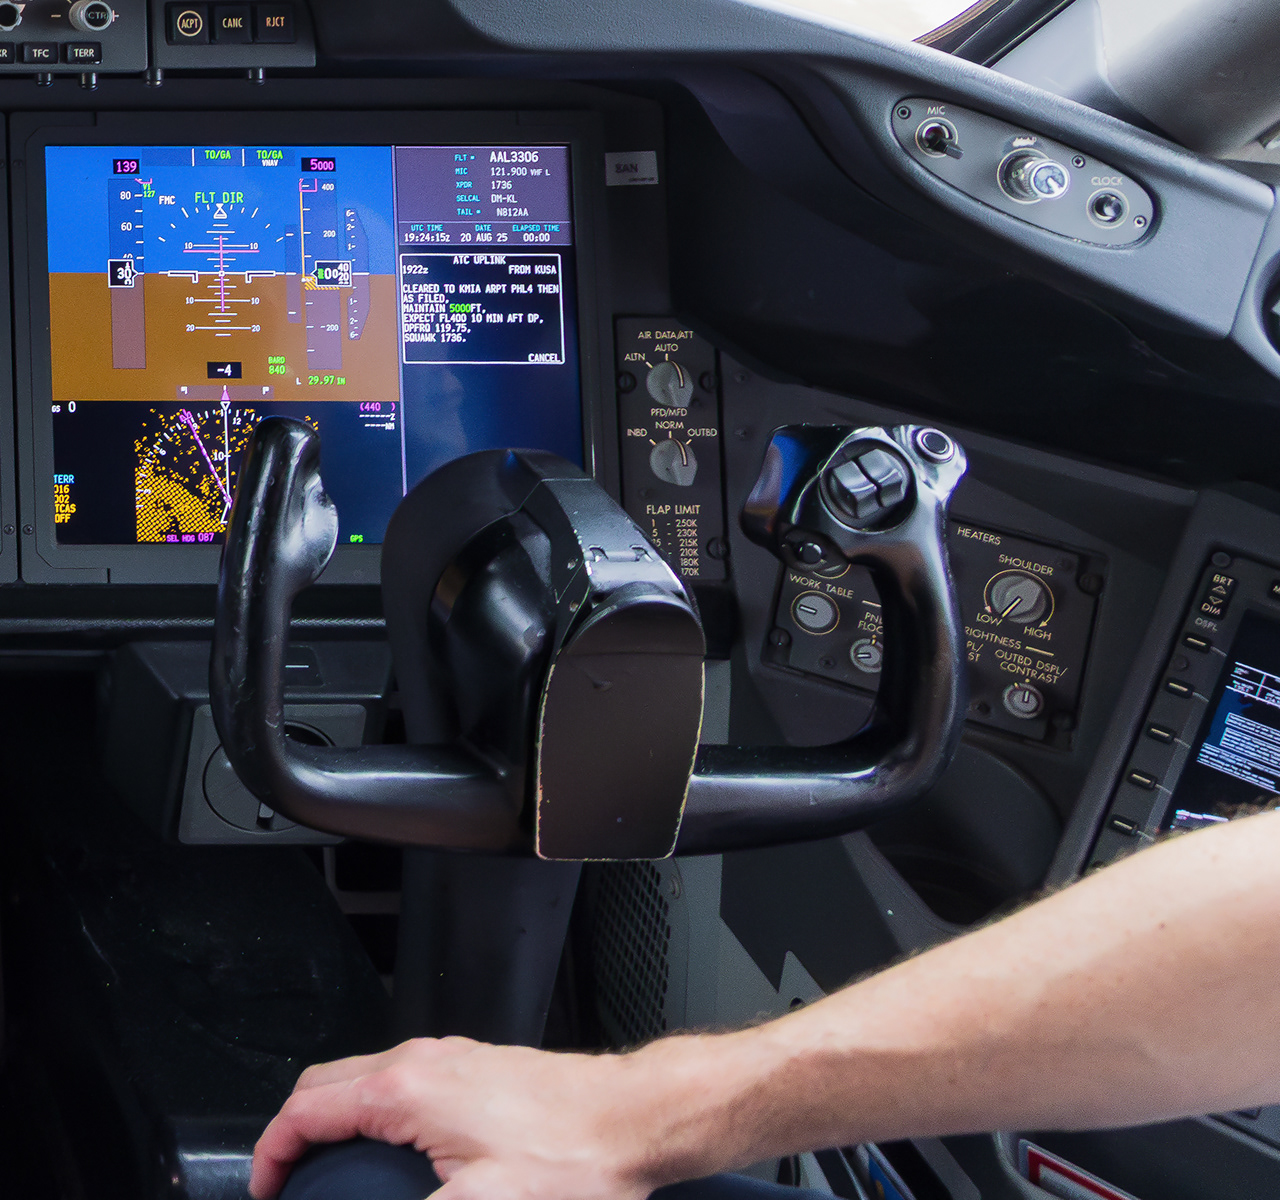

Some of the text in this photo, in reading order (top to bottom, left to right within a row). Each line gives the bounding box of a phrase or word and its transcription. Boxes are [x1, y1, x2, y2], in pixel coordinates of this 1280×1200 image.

[266, 17, 284, 27] RJCT
[490, 151, 538, 162] AAL3306
[491, 167, 527, 176] 121.900
[1091, 176, 1122, 185] CLOCK
[1213, 574, 1233, 586] BRT
[790, 574, 854, 600] WORK TABLE
